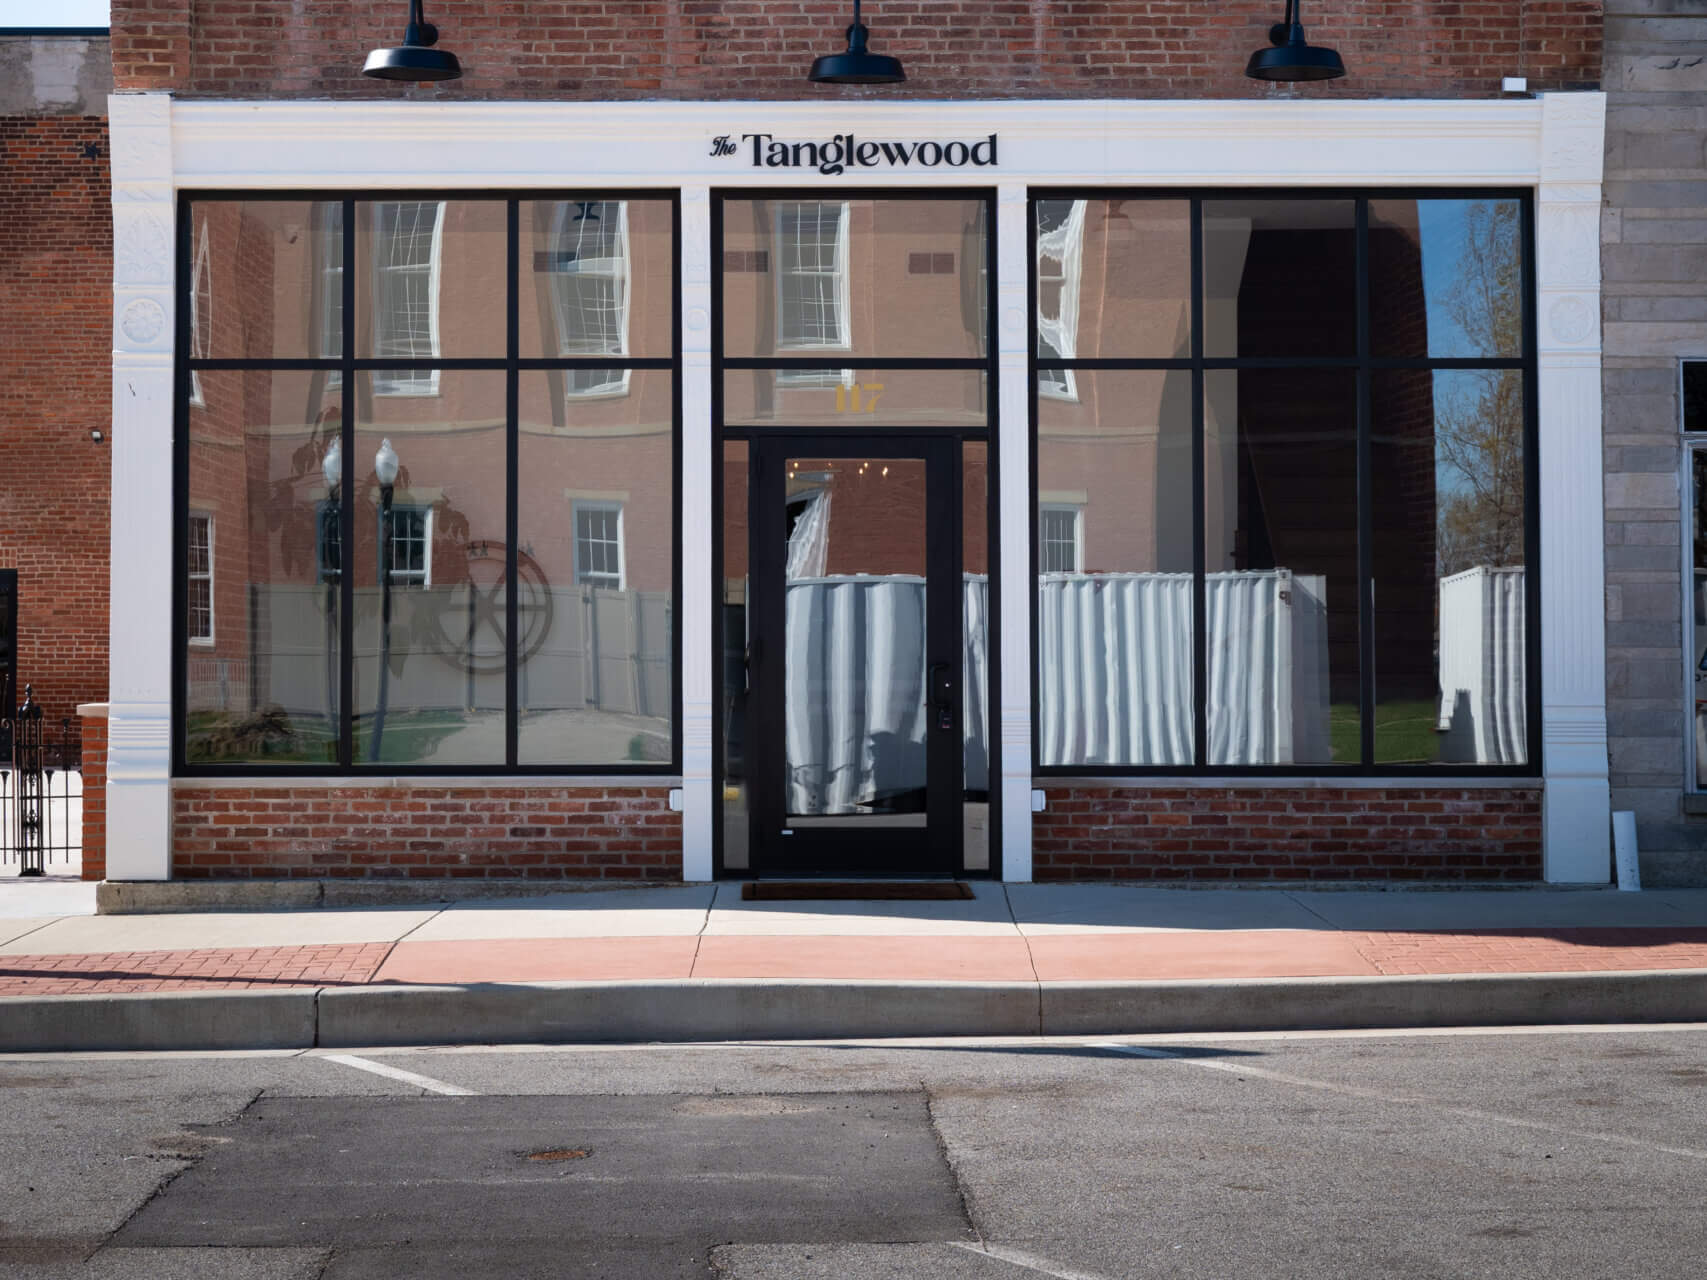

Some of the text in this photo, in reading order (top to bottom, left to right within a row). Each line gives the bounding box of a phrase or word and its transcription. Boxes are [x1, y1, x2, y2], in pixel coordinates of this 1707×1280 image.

[709, 134, 998, 175] The Tanglewood
[835, 384, 884, 412] 117
